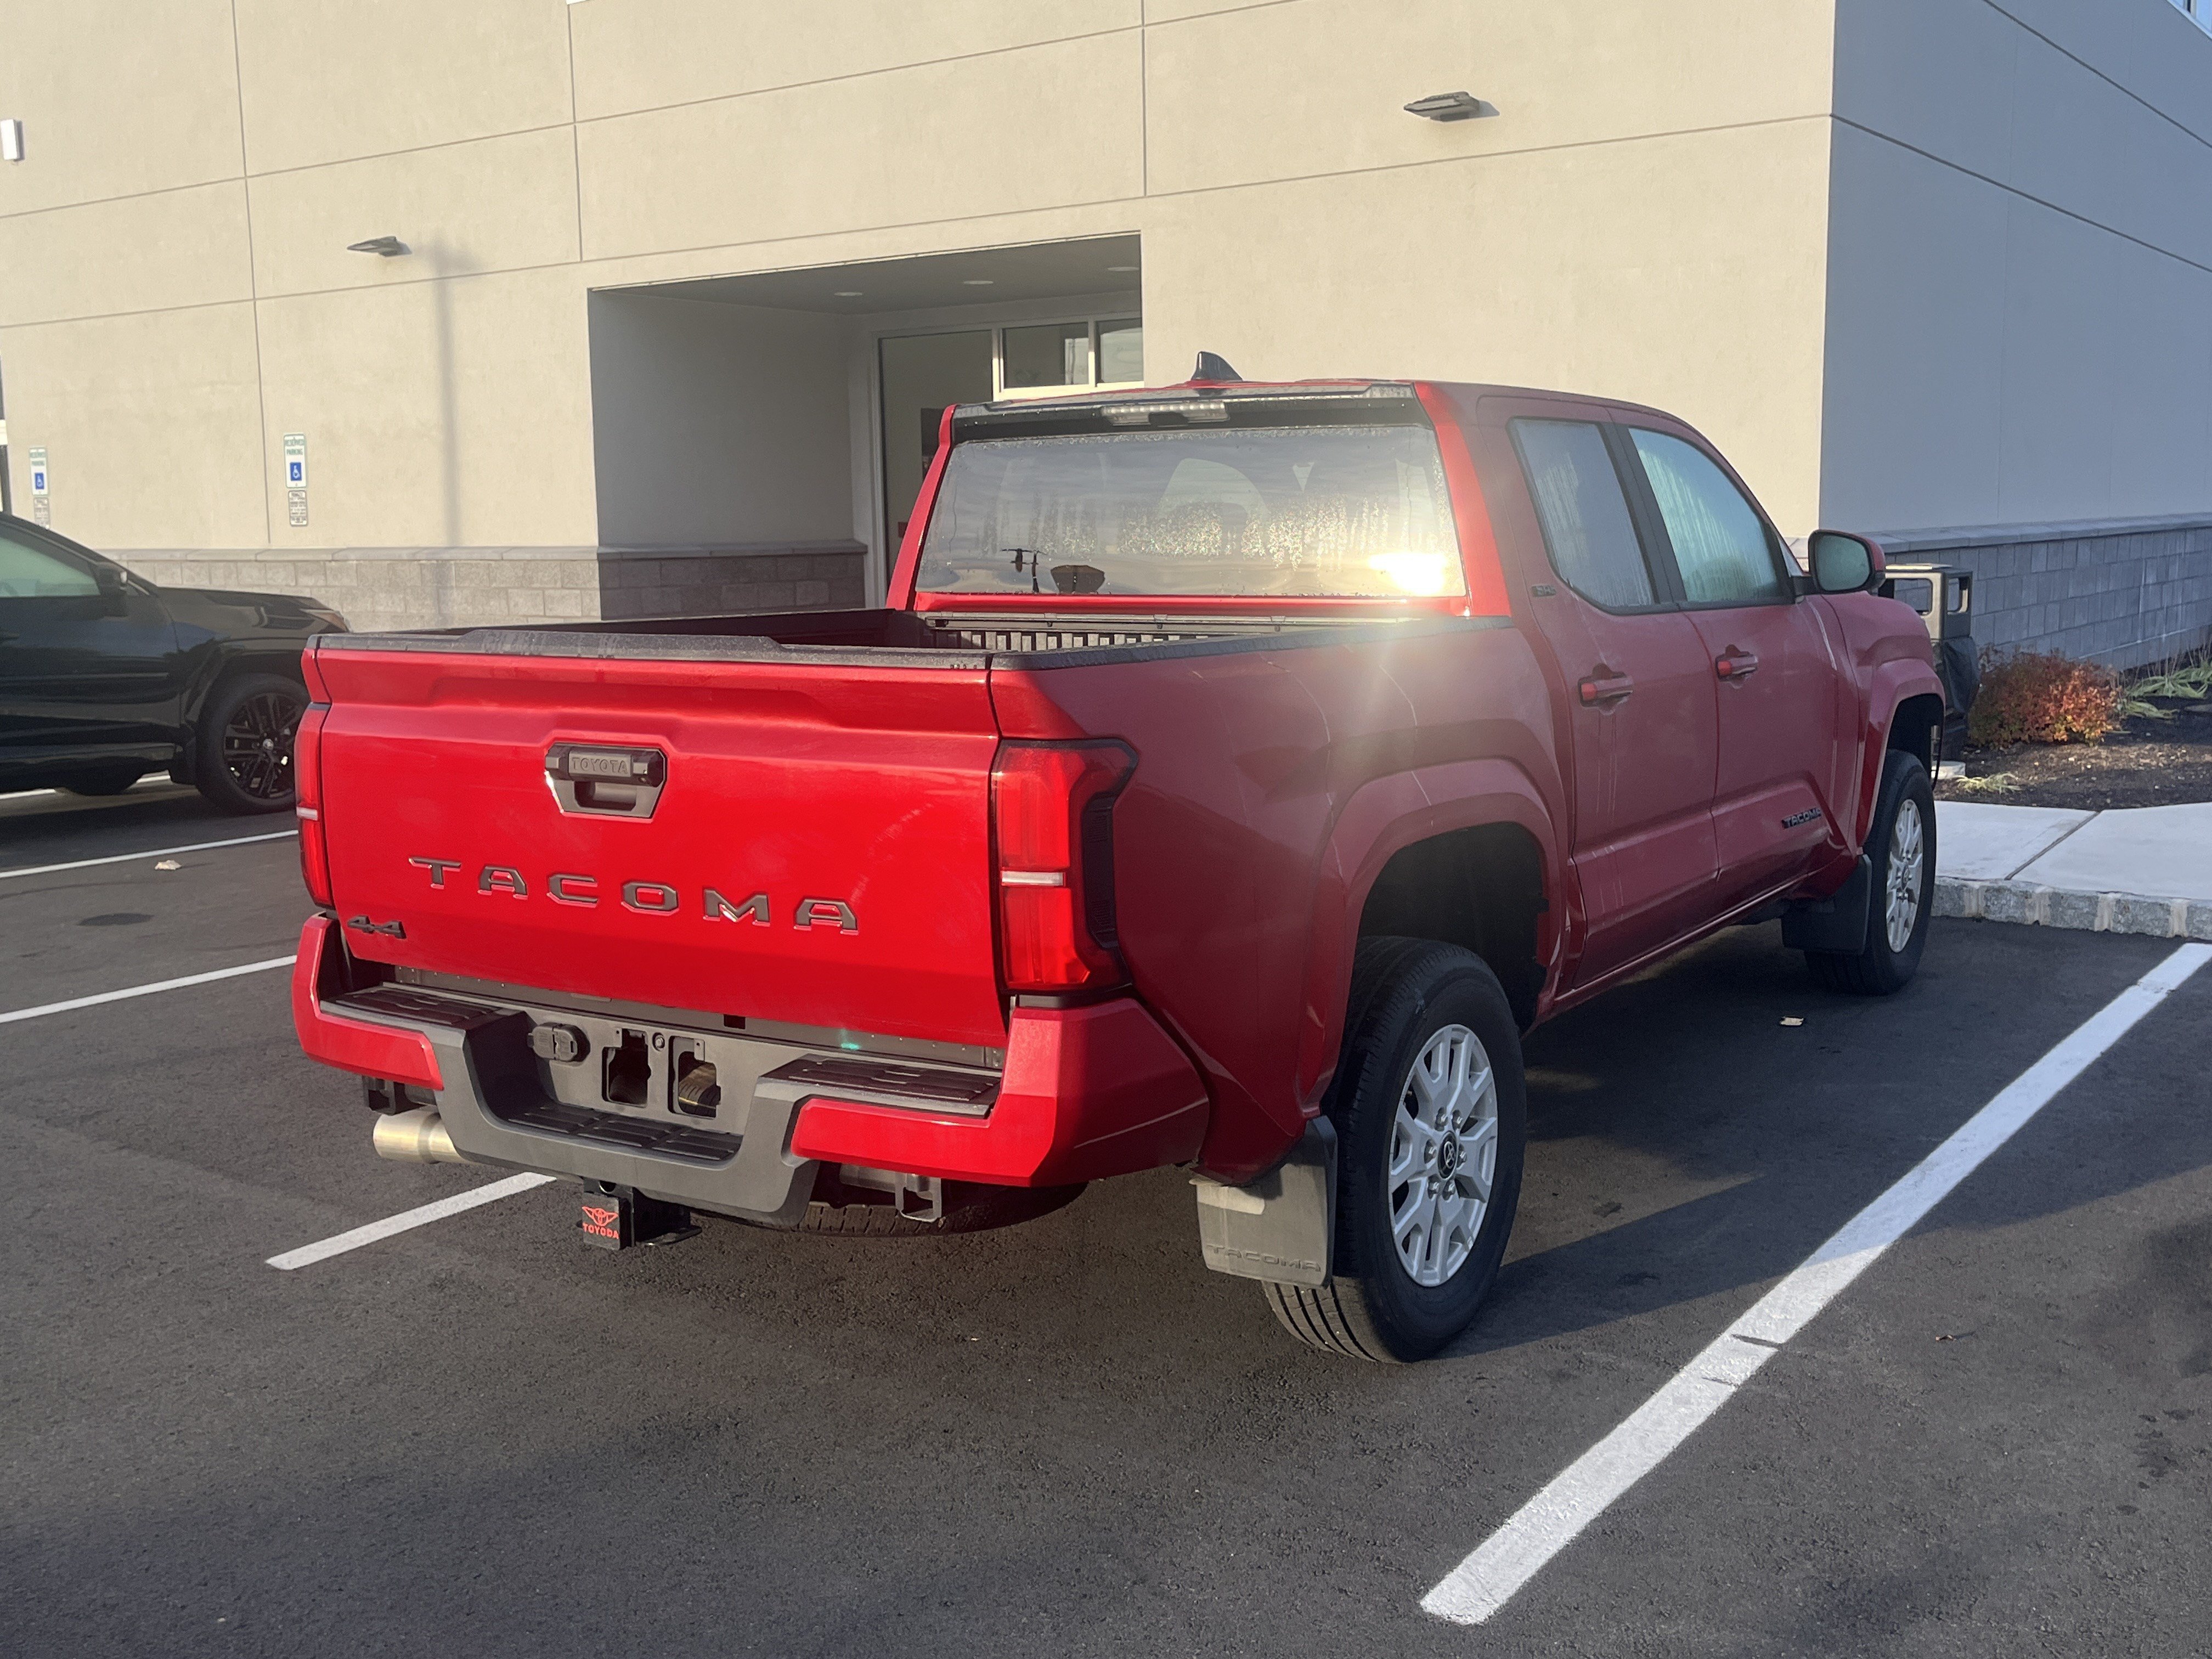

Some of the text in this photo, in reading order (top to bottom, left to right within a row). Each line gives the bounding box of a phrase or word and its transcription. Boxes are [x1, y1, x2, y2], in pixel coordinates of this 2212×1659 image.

[572, 757, 628, 774] TOYOTA
[1781, 806, 1822, 828] TACOMA
[408, 855, 859, 935] TACOMA
[582, 1223, 620, 1240] TOYODA
[1206, 1244, 1321, 1272] TACOMA
